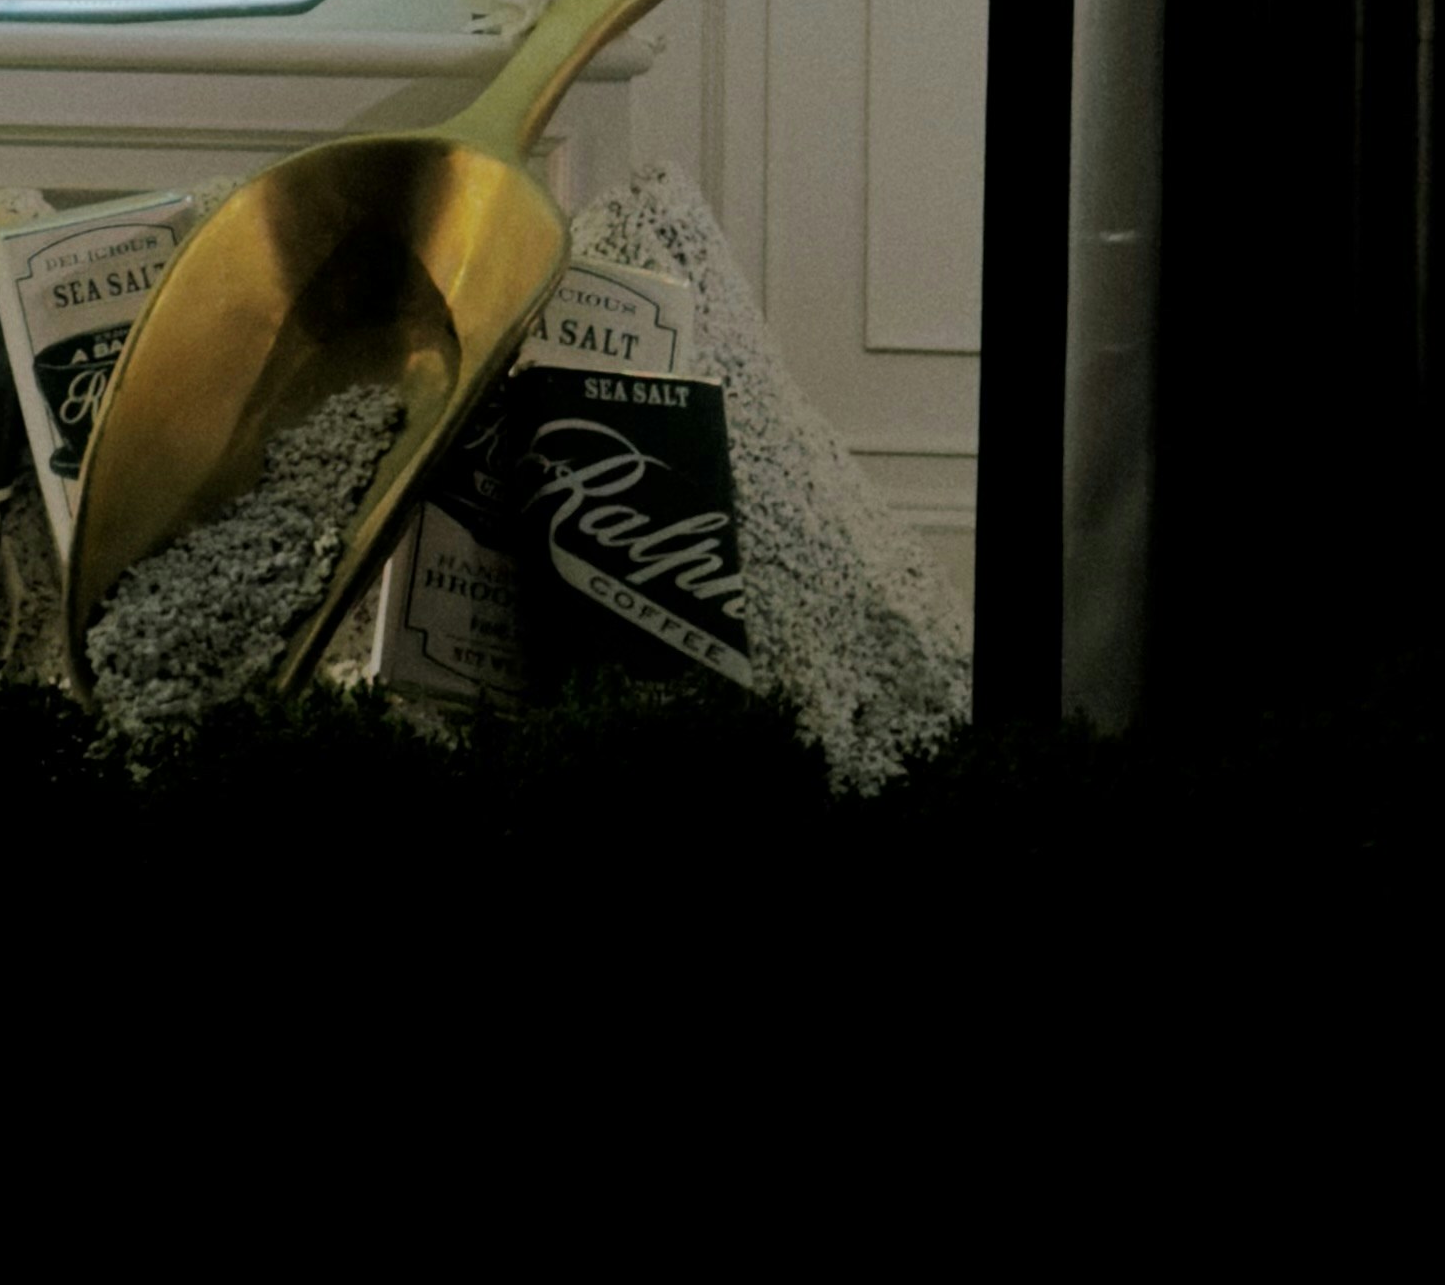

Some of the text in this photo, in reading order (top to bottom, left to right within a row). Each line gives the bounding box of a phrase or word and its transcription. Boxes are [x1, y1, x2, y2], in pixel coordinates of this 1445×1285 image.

[44, 236, 159, 272] DELICIOUS
[52, 278, 103, 309] SEA
[558, 287, 637, 316] CIOUS
[94, 340, 125, 359] BA
[558, 317, 641, 362] SALT
[584, 377, 690, 408] SEA SALT
[586, 573, 728, 667] COFFEE
